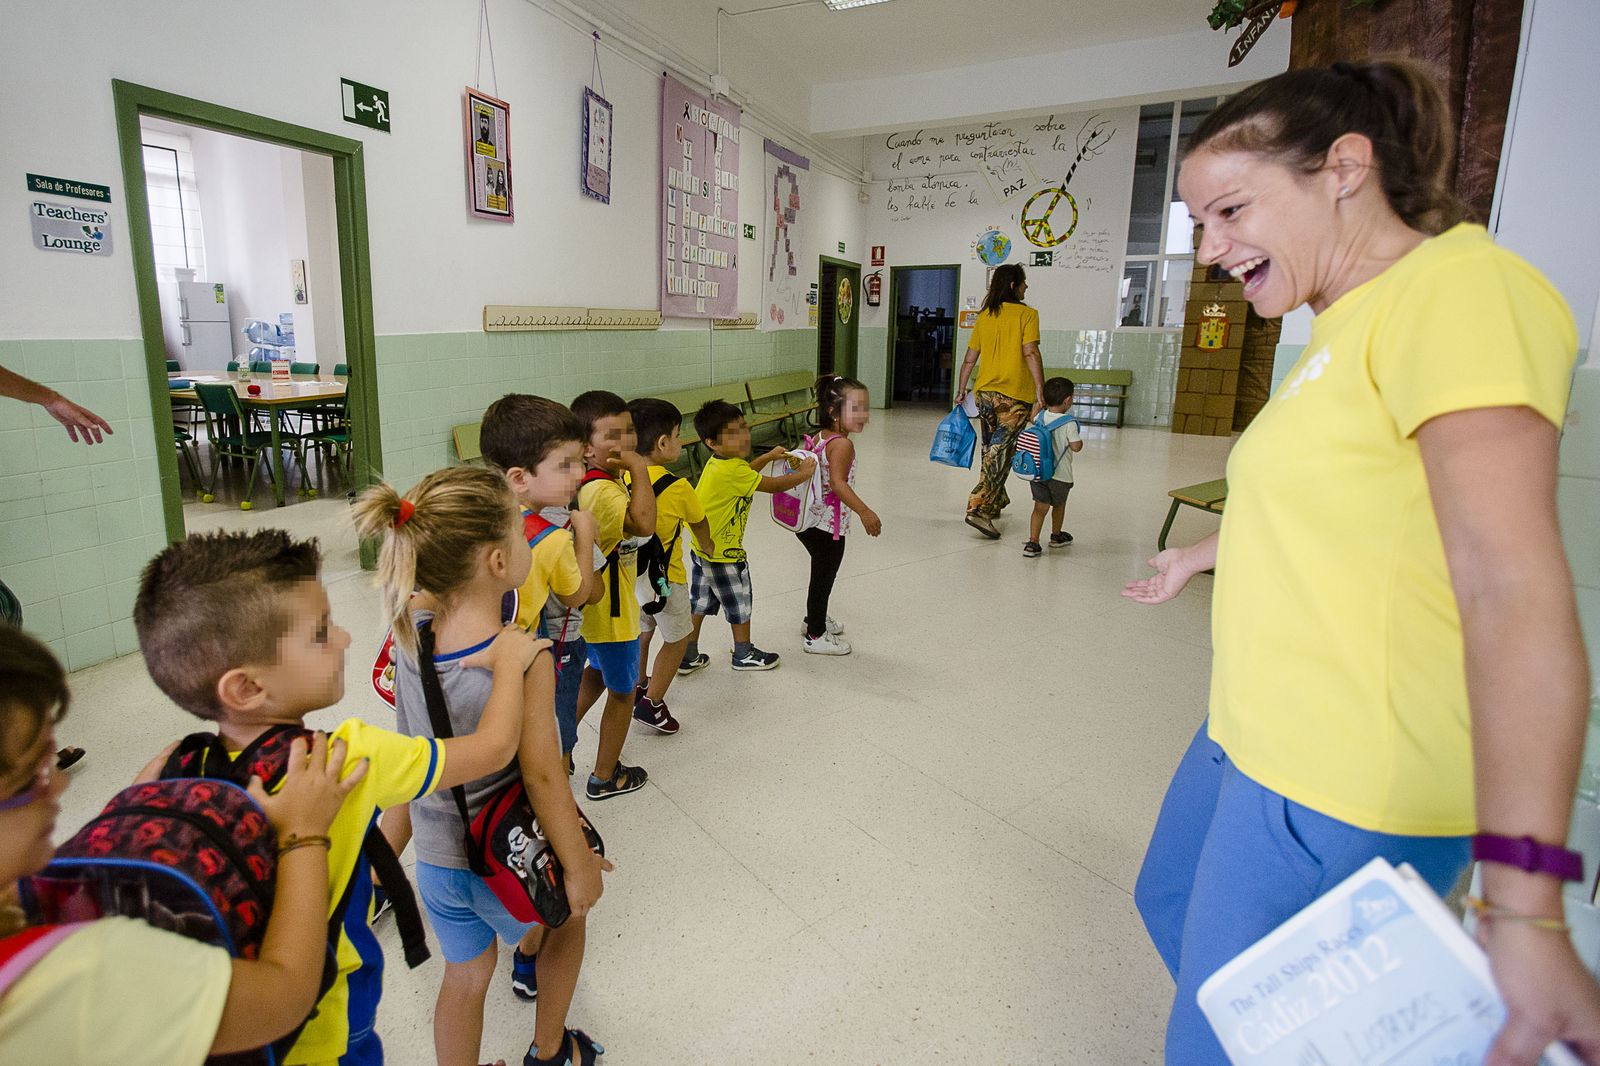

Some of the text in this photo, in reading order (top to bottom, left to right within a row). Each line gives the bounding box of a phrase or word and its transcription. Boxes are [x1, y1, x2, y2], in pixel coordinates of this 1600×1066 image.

[1234, 4, 1281, 57] INFAN
[886, 114, 1067, 150] Cuando me preguntaron sobre
[891, 134, 1068, 171] el arma para contrarrestar la
[35, 178, 104, 198] Sala de Profesores
[944, 191, 959, 208] de
[967, 189, 980, 206] la
[1003, 178, 1028, 198] PAZ
[42, 234, 101, 254] Lounge
[1228, 994, 1257, 1016] The
[1252, 973, 1284, 999] Tall
[1280, 952, 1321, 982] Ships
[1237, 994, 1322, 1056] Cádiz
[1306, 934, 1405, 1010] 2012
